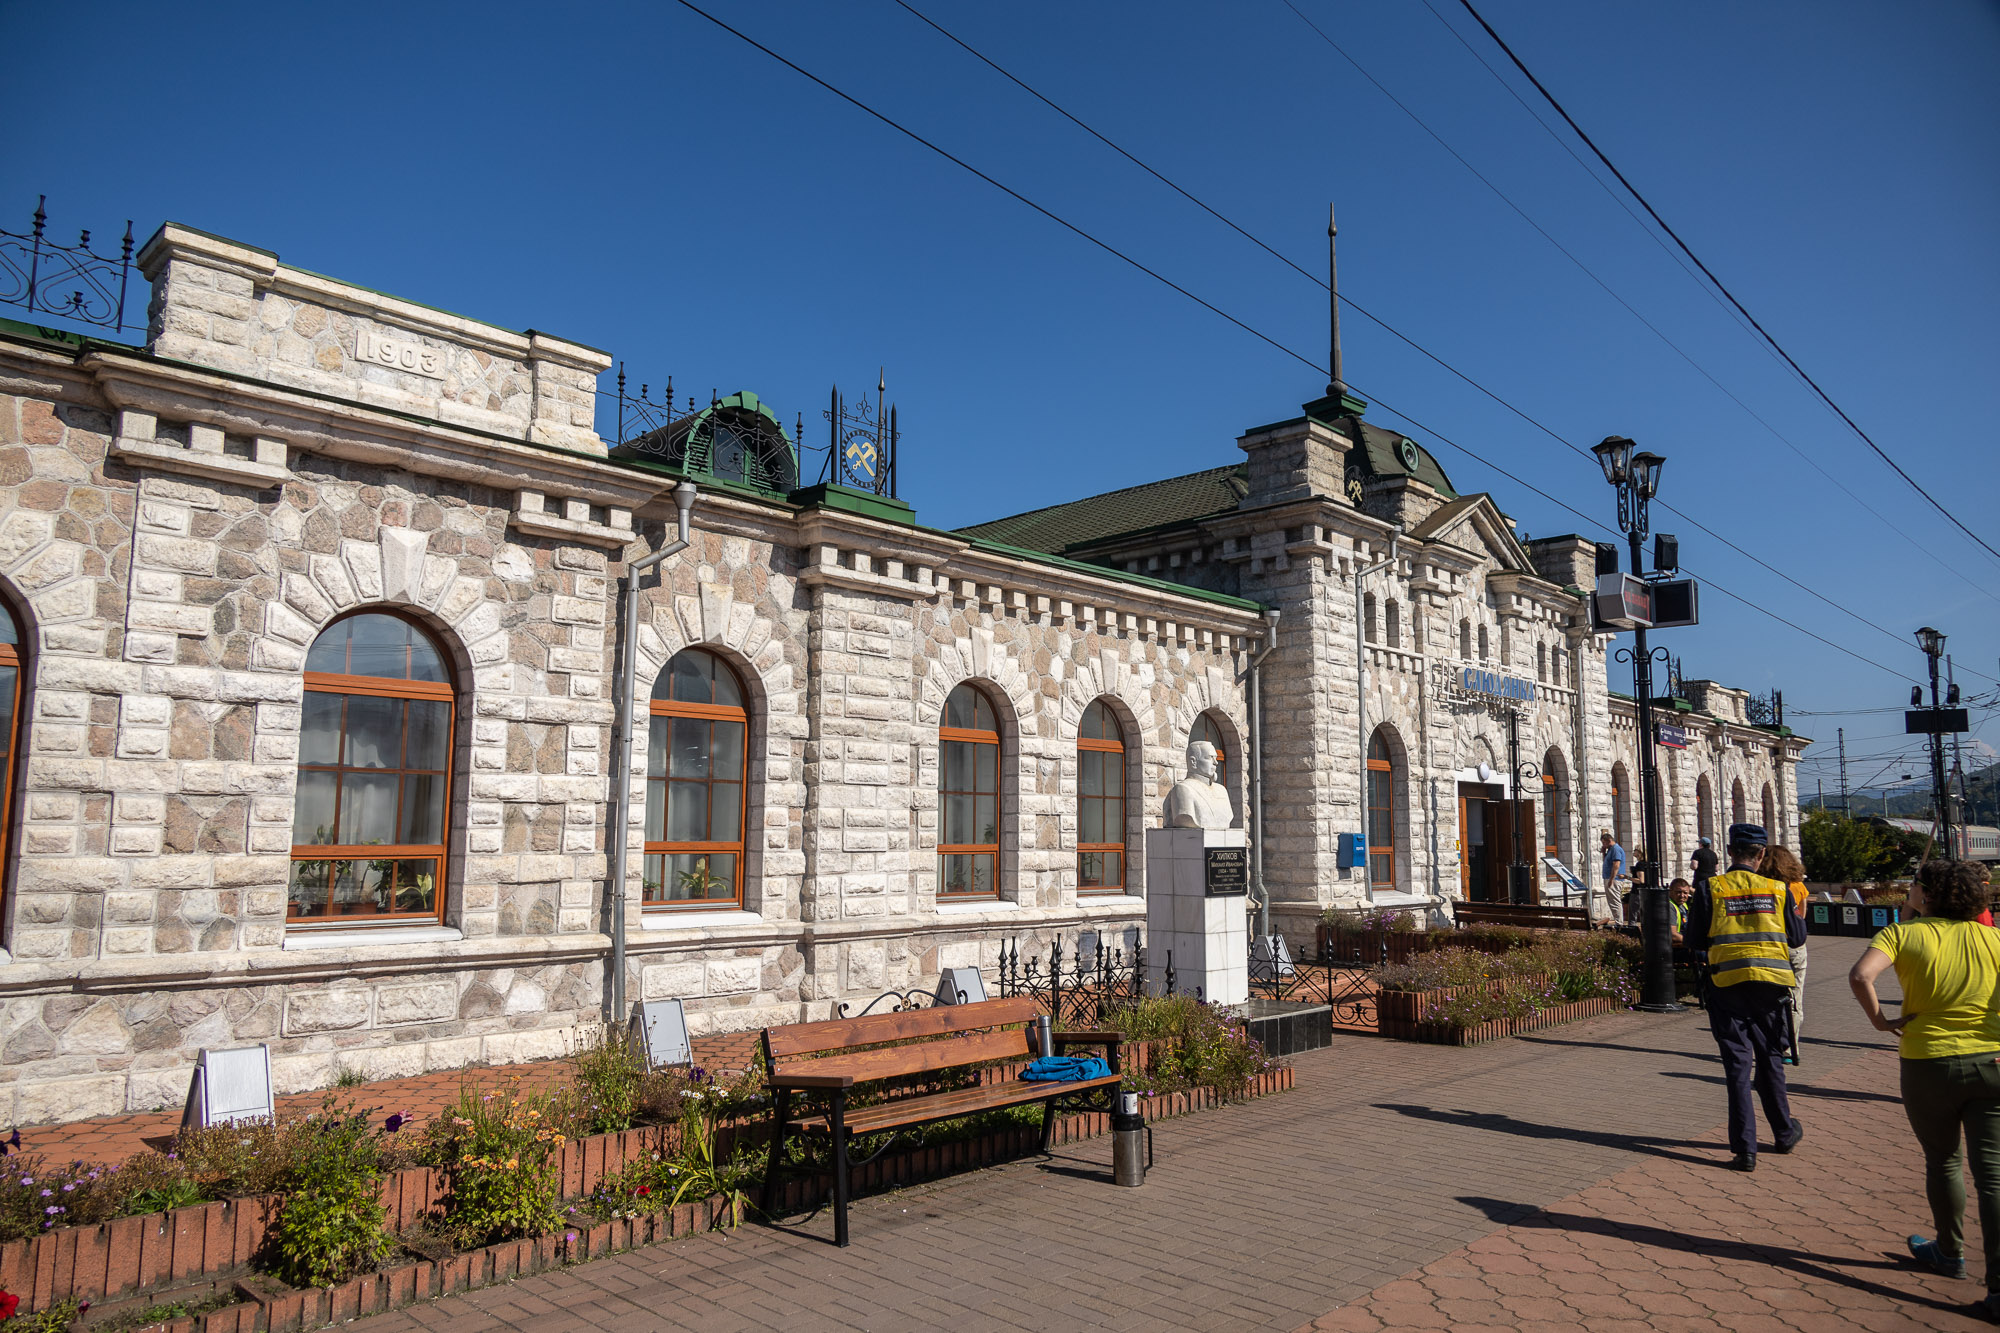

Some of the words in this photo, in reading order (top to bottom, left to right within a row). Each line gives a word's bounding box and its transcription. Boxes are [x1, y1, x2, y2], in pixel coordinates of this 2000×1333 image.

[366, 335, 438, 374] 1903
[1463, 667, 1535, 702] СЛЮДЯНКА
[1216, 852, 1238, 861] ХИЛКОВ
